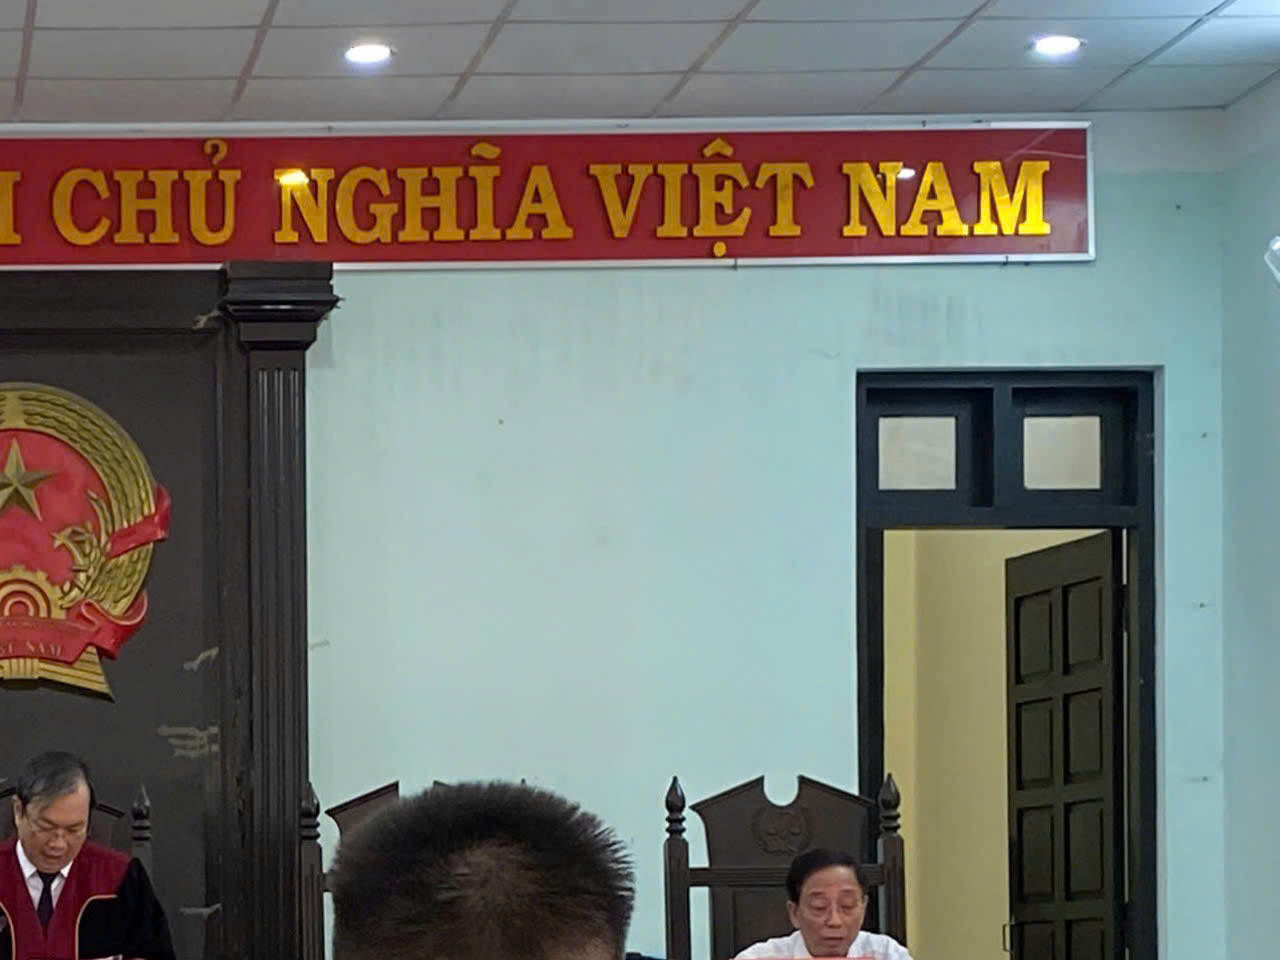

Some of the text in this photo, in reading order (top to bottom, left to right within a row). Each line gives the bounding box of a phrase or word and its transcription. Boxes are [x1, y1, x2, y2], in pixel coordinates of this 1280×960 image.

[51, 139, 242, 246] CHỦ
[272, 140, 574, 246] NGHĨA
[588, 136, 815, 258] VIỆT
[841, 159, 1051, 237] NAM
